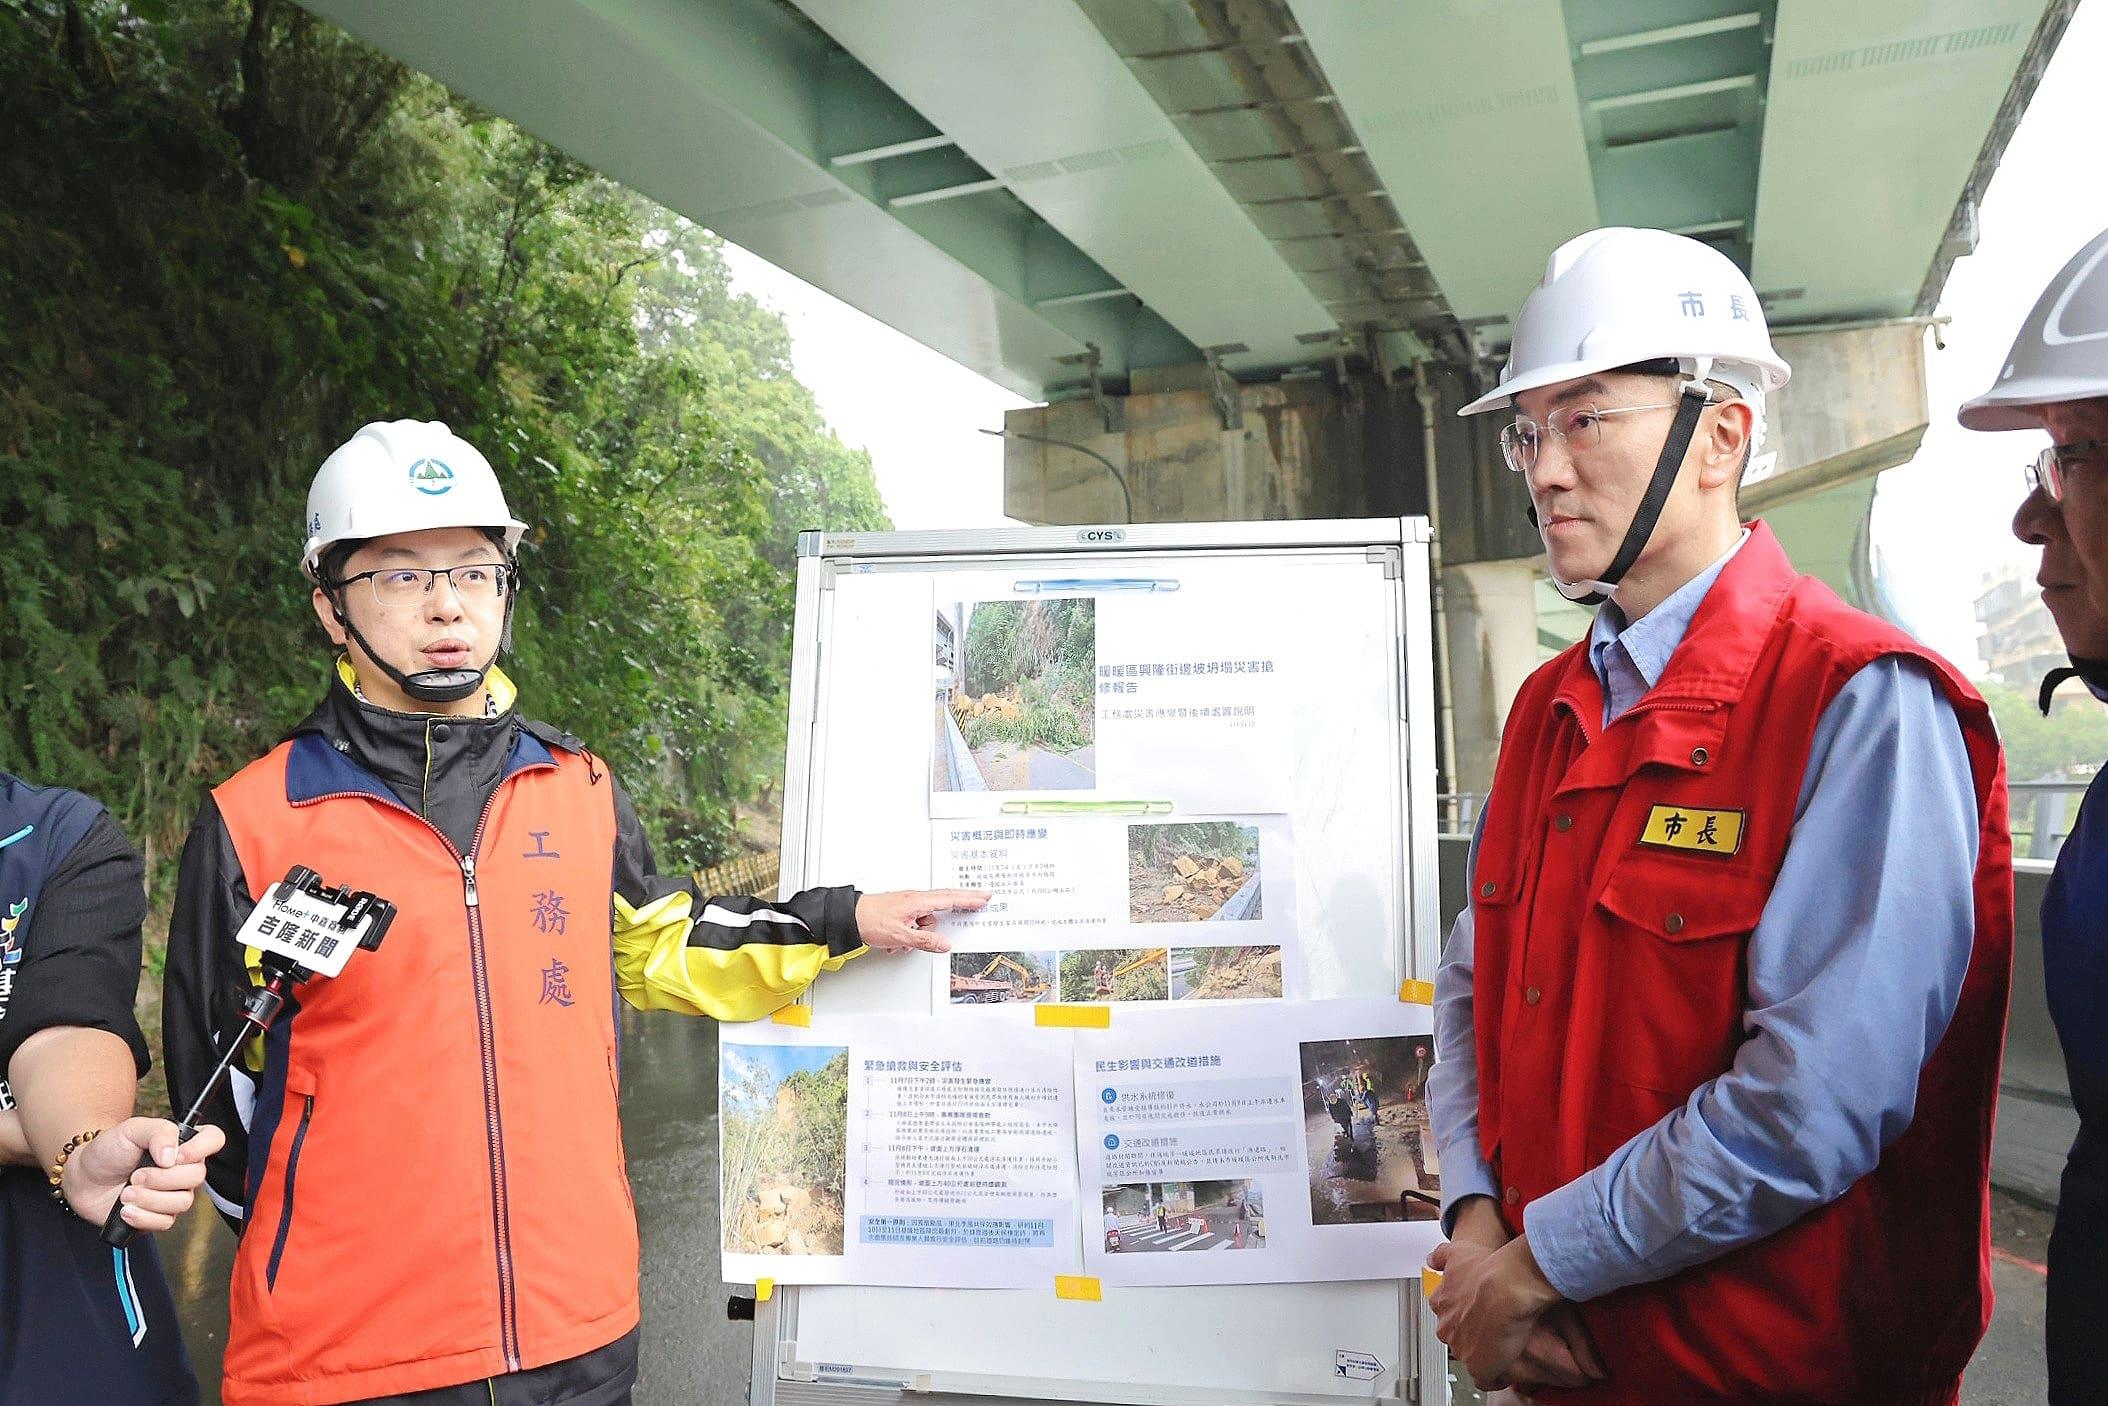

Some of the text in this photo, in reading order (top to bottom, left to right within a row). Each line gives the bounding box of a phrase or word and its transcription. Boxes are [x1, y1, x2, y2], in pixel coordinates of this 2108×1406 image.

[1678, 291, 1750, 321] 市長
[1087, 531, 1113, 541] CYS
[1098, 681, 1138, 694] 修報告
[1664, 811, 1718, 845] 市長
[522, 831, 575, 1007] 工務處
[257, 915, 340, 959] 吉隆新聞
[864, 1060, 963, 1072] 緊急搶救與安全評估
[1095, 1055, 1222, 1073] 民生影響與交通改道措施
